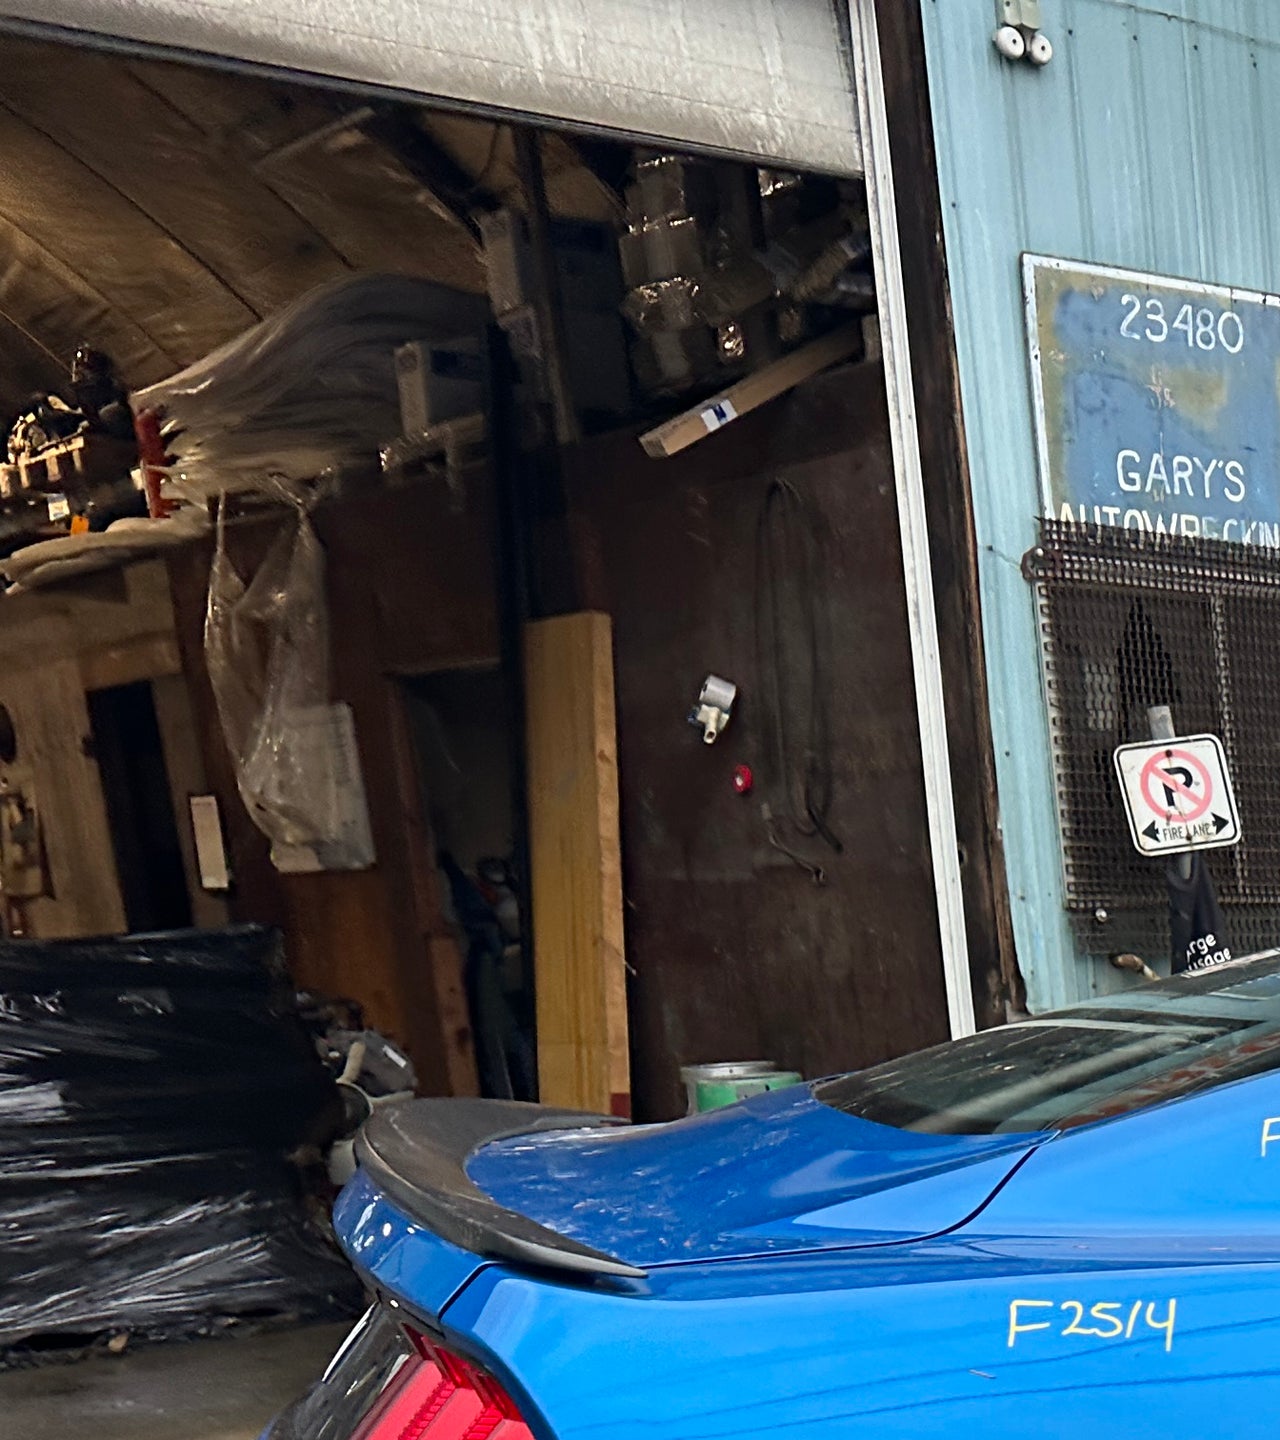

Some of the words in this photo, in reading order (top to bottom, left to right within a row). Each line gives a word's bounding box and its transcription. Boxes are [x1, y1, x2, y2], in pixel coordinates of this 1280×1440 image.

[1120, 294, 1244, 353] 23480
[1117, 449, 1245, 502] GARY'S
[1162, 825, 1185, 842] FIRE
[1186, 933, 1216, 962] rge
[1007, 1298, 1176, 1352] F2514
